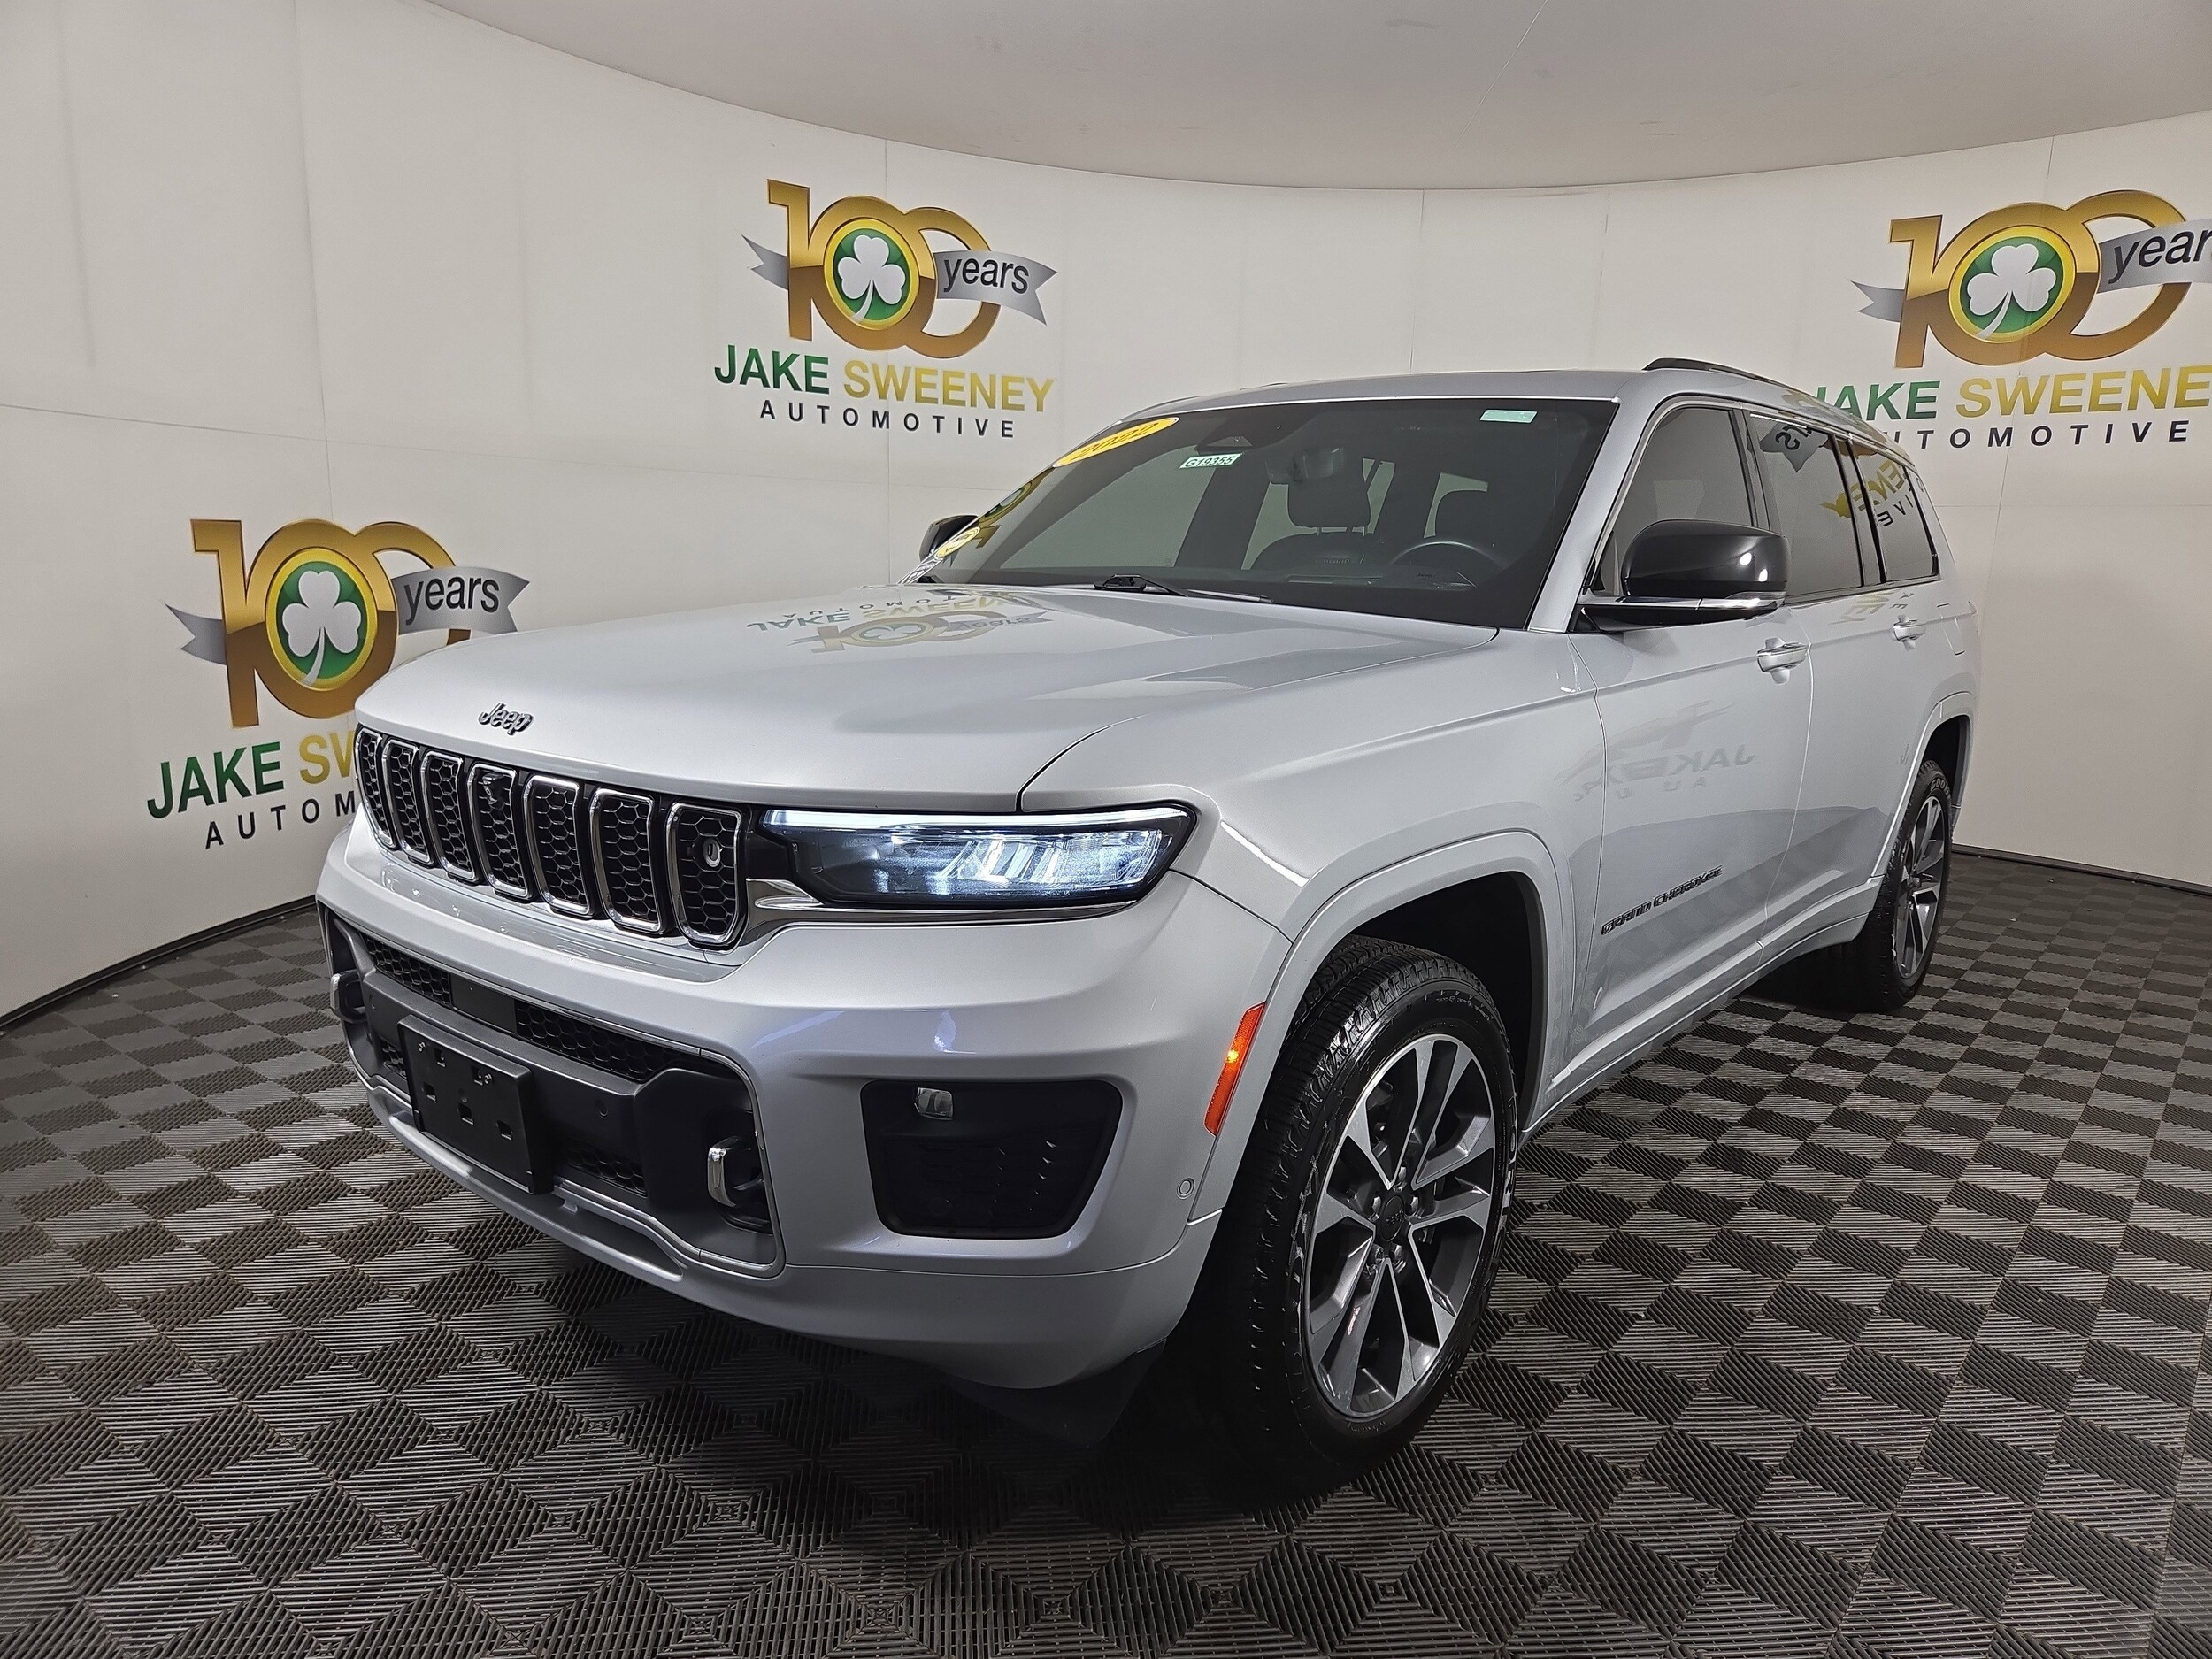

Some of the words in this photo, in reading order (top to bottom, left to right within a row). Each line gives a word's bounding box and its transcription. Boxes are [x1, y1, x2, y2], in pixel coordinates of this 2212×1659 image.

[767, 179, 1001, 359] 100
[943, 257, 1029, 294] years
[1889, 189, 2192, 369] 100
[2108, 230, 2212, 284] year
[714, 345, 830, 394] JAKE
[843, 360, 1055, 412] SWEENEY
[1955, 365, 2212, 418] SWEENE
[760, 400, 1013, 437] AUTOMOTIVE
[1883, 420, 2189, 449] TOMOTIVE
[1184, 455, 1233, 468] G19355
[190, 518, 470, 728] 100
[403, 576, 500, 626] years
[478, 703, 534, 736] Jeep
[147, 741, 285, 819] JAKE
[205, 794, 355, 849] AUTOM
[1601, 901, 1652, 935] GRAND
[1653, 864, 1724, 907] CHEROKEE
